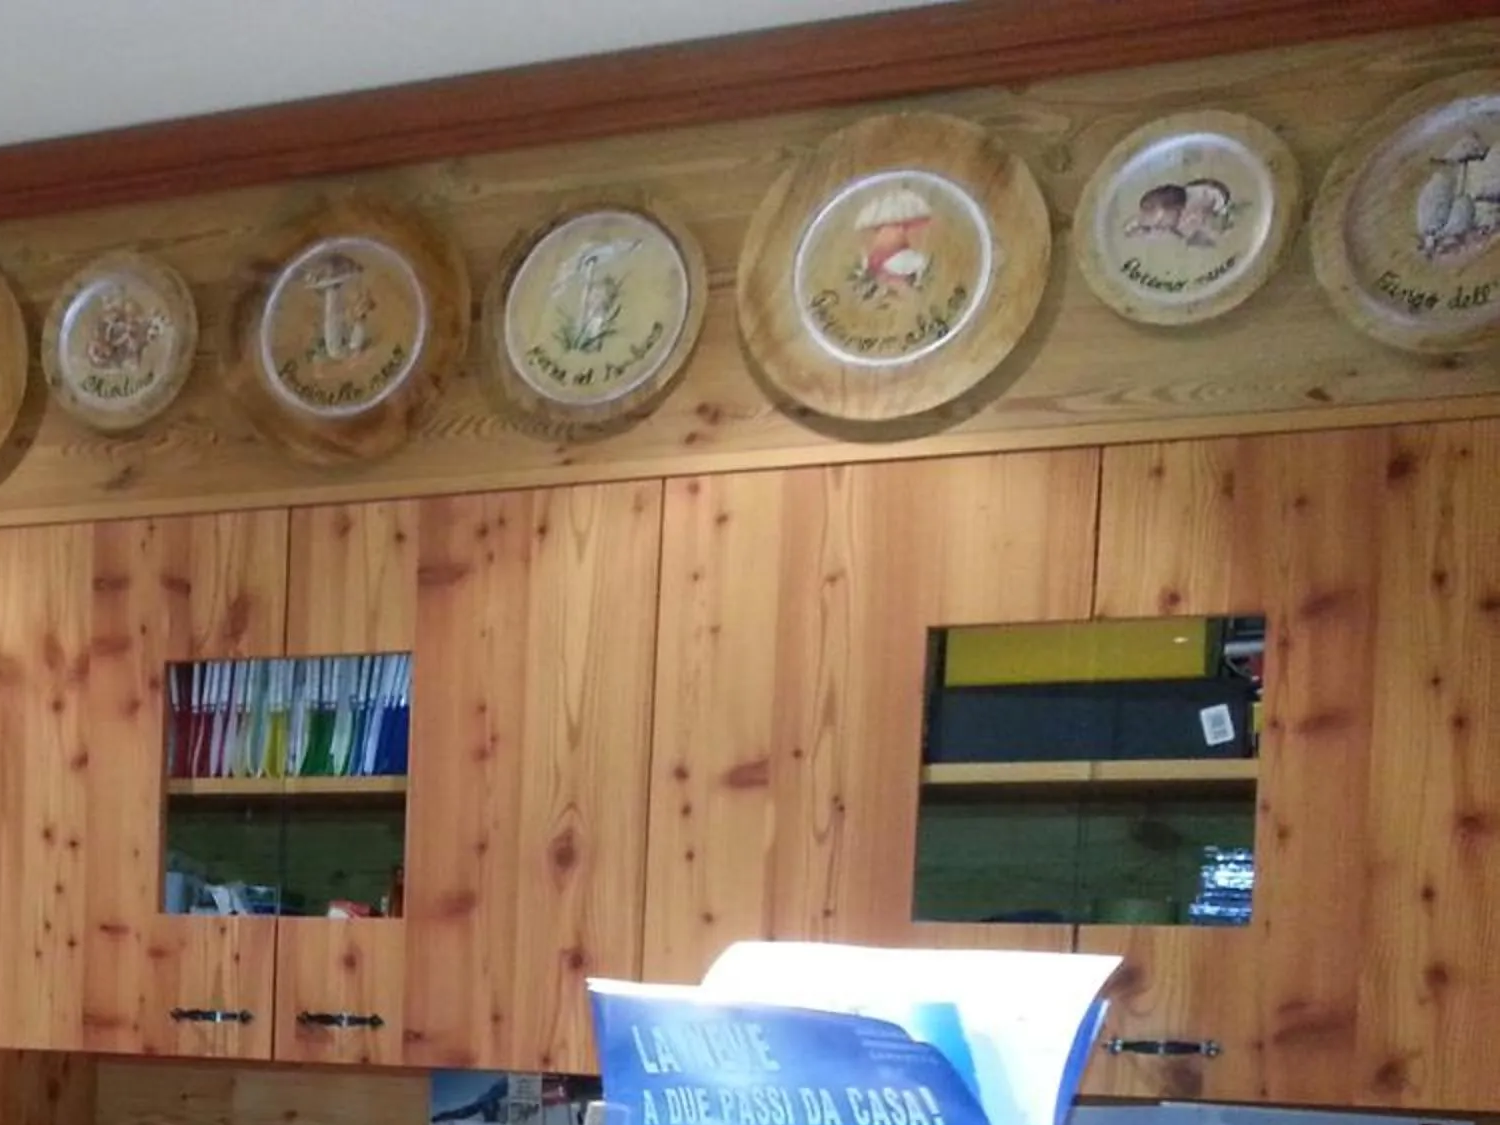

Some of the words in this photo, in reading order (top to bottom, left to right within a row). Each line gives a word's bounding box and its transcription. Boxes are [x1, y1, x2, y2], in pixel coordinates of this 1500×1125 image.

[631, 1023, 682, 1073] LA
[643, 1088, 660, 1125] A
[663, 1086, 710, 1125] DUE
